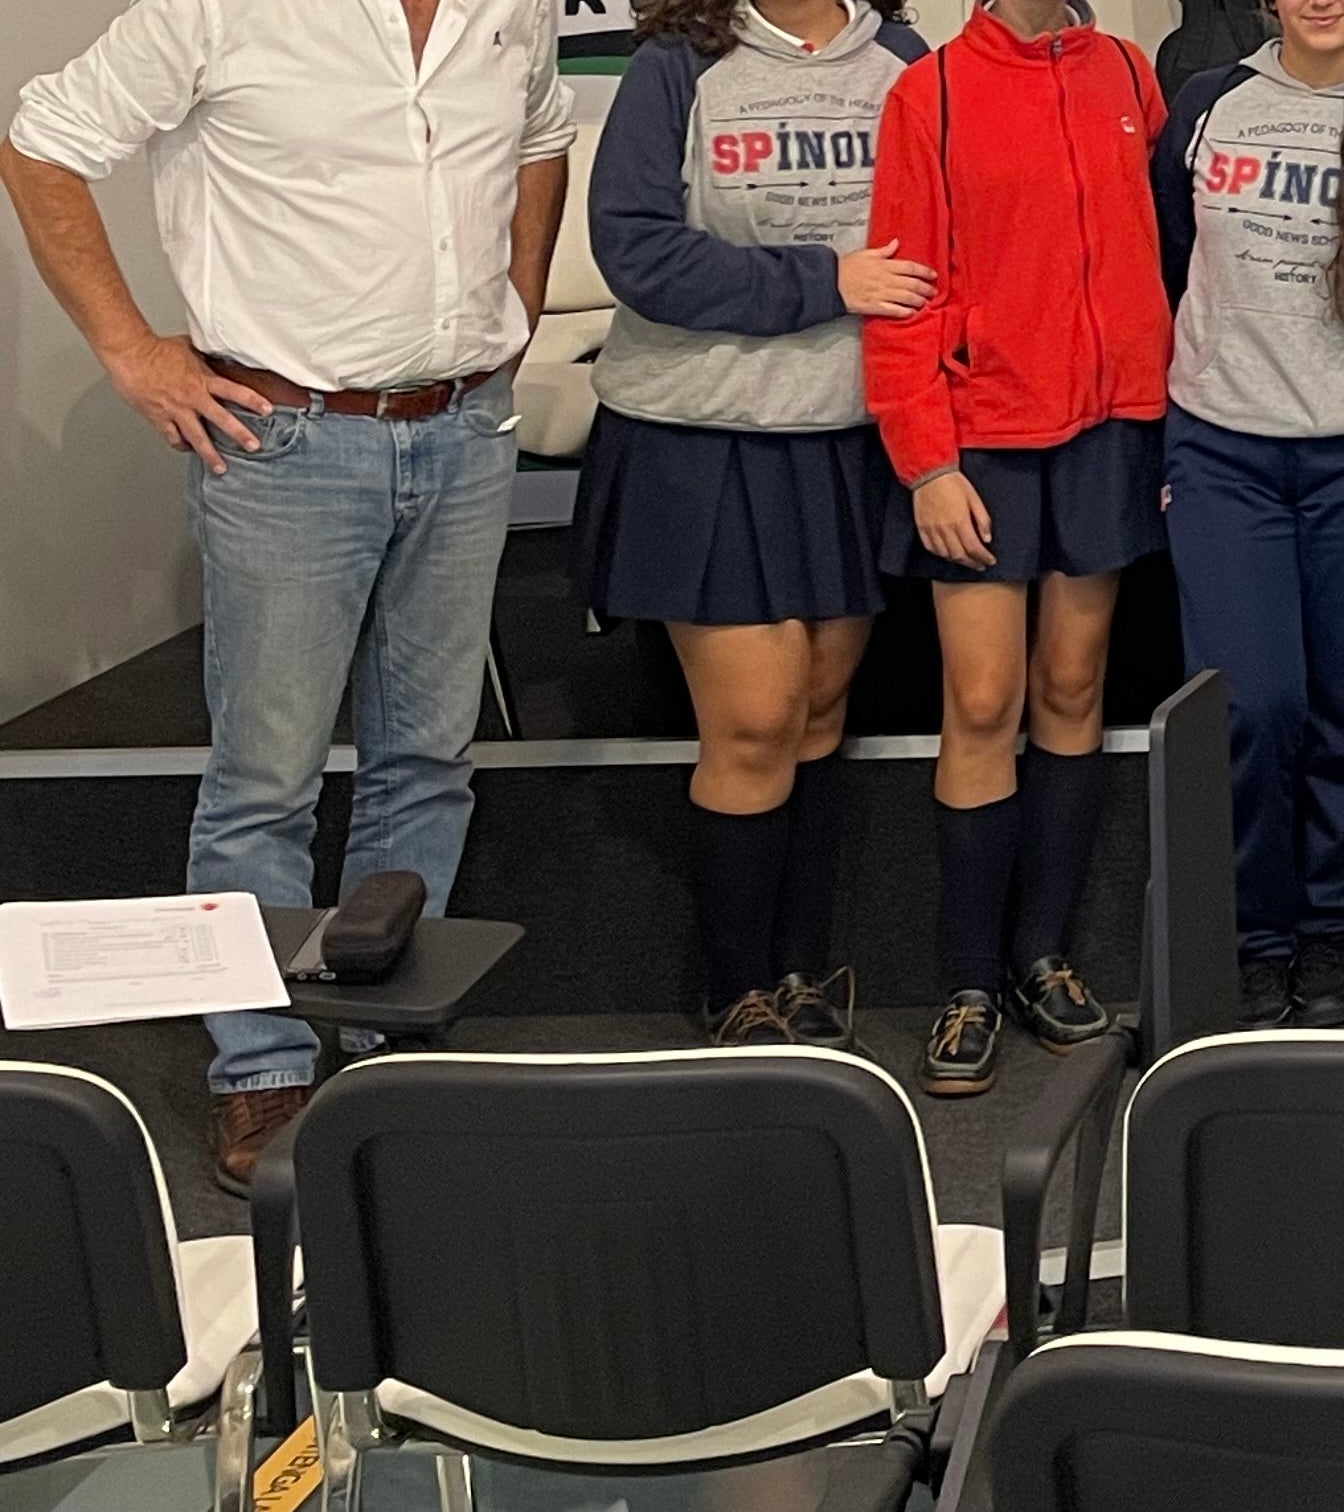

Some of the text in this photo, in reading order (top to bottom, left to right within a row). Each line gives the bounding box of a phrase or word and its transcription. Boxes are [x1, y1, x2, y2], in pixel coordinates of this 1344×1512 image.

[712, 122, 875, 175] SPÍNOL
[1328, 126, 1344, 138] TH
[1205, 150, 1343, 207] SPÍNO
